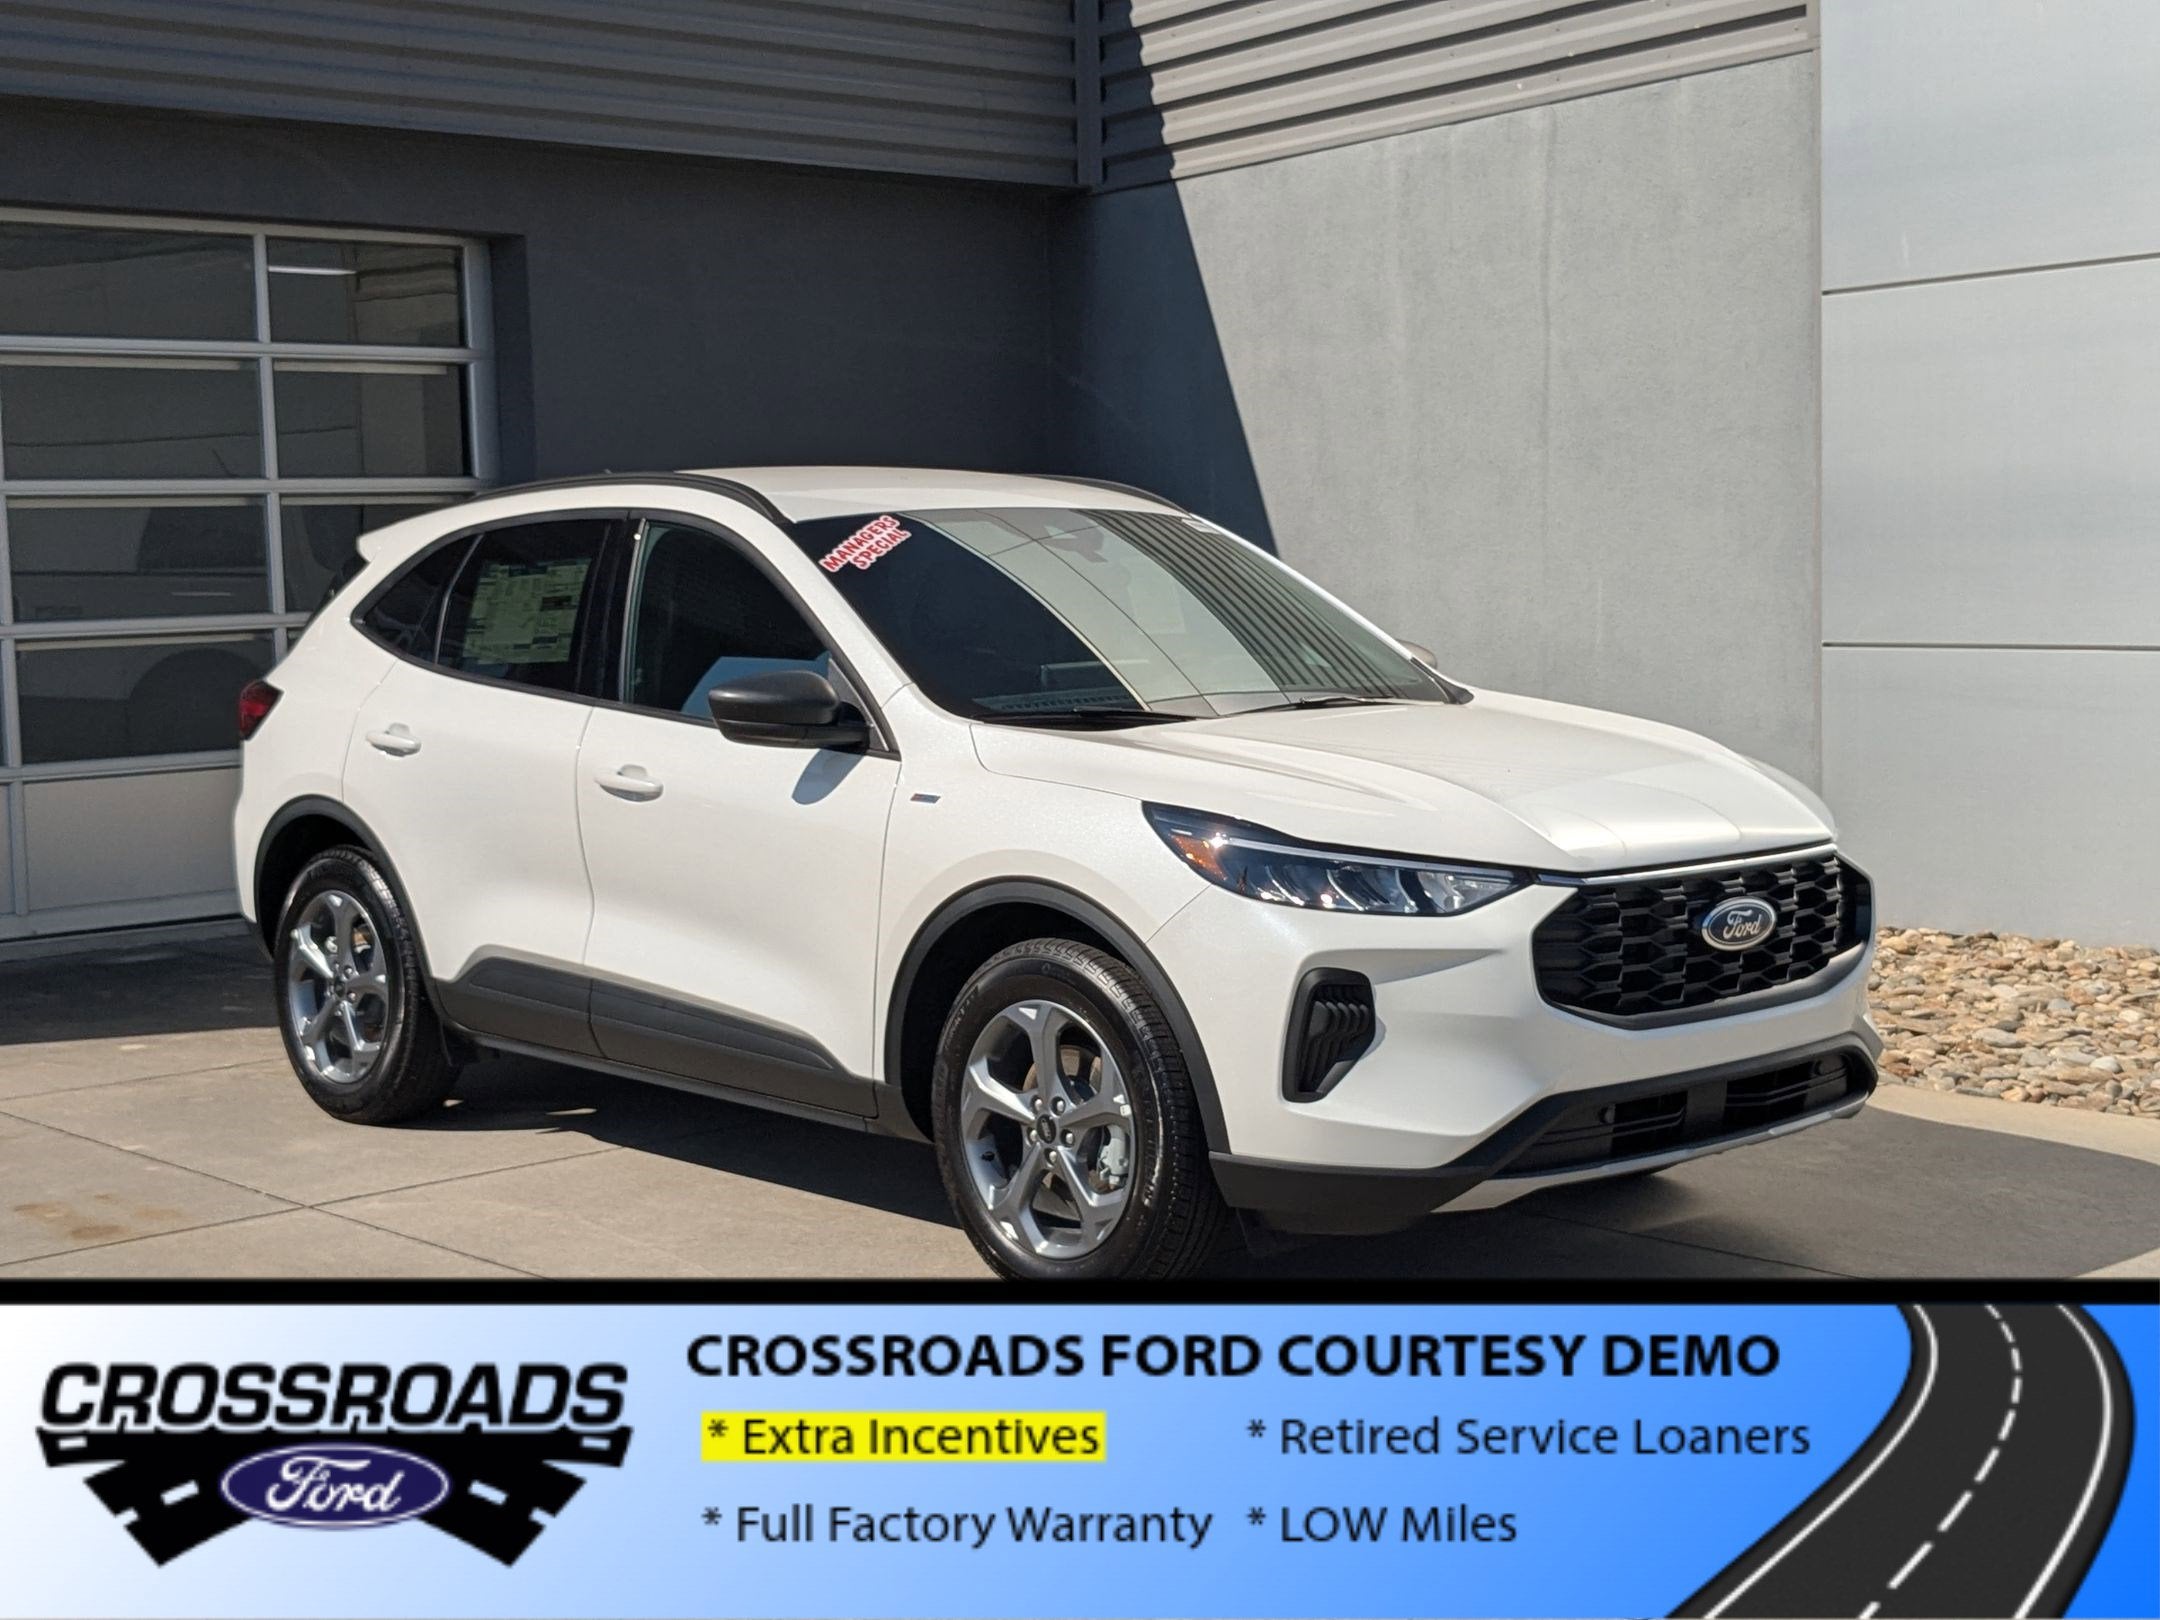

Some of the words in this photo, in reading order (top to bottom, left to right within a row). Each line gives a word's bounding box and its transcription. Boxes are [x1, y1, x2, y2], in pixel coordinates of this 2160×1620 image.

[822, 515, 898, 571] MANAGERS
[852, 530, 908, 568] SPECIAL
[1722, 909, 1763, 940] Ford
